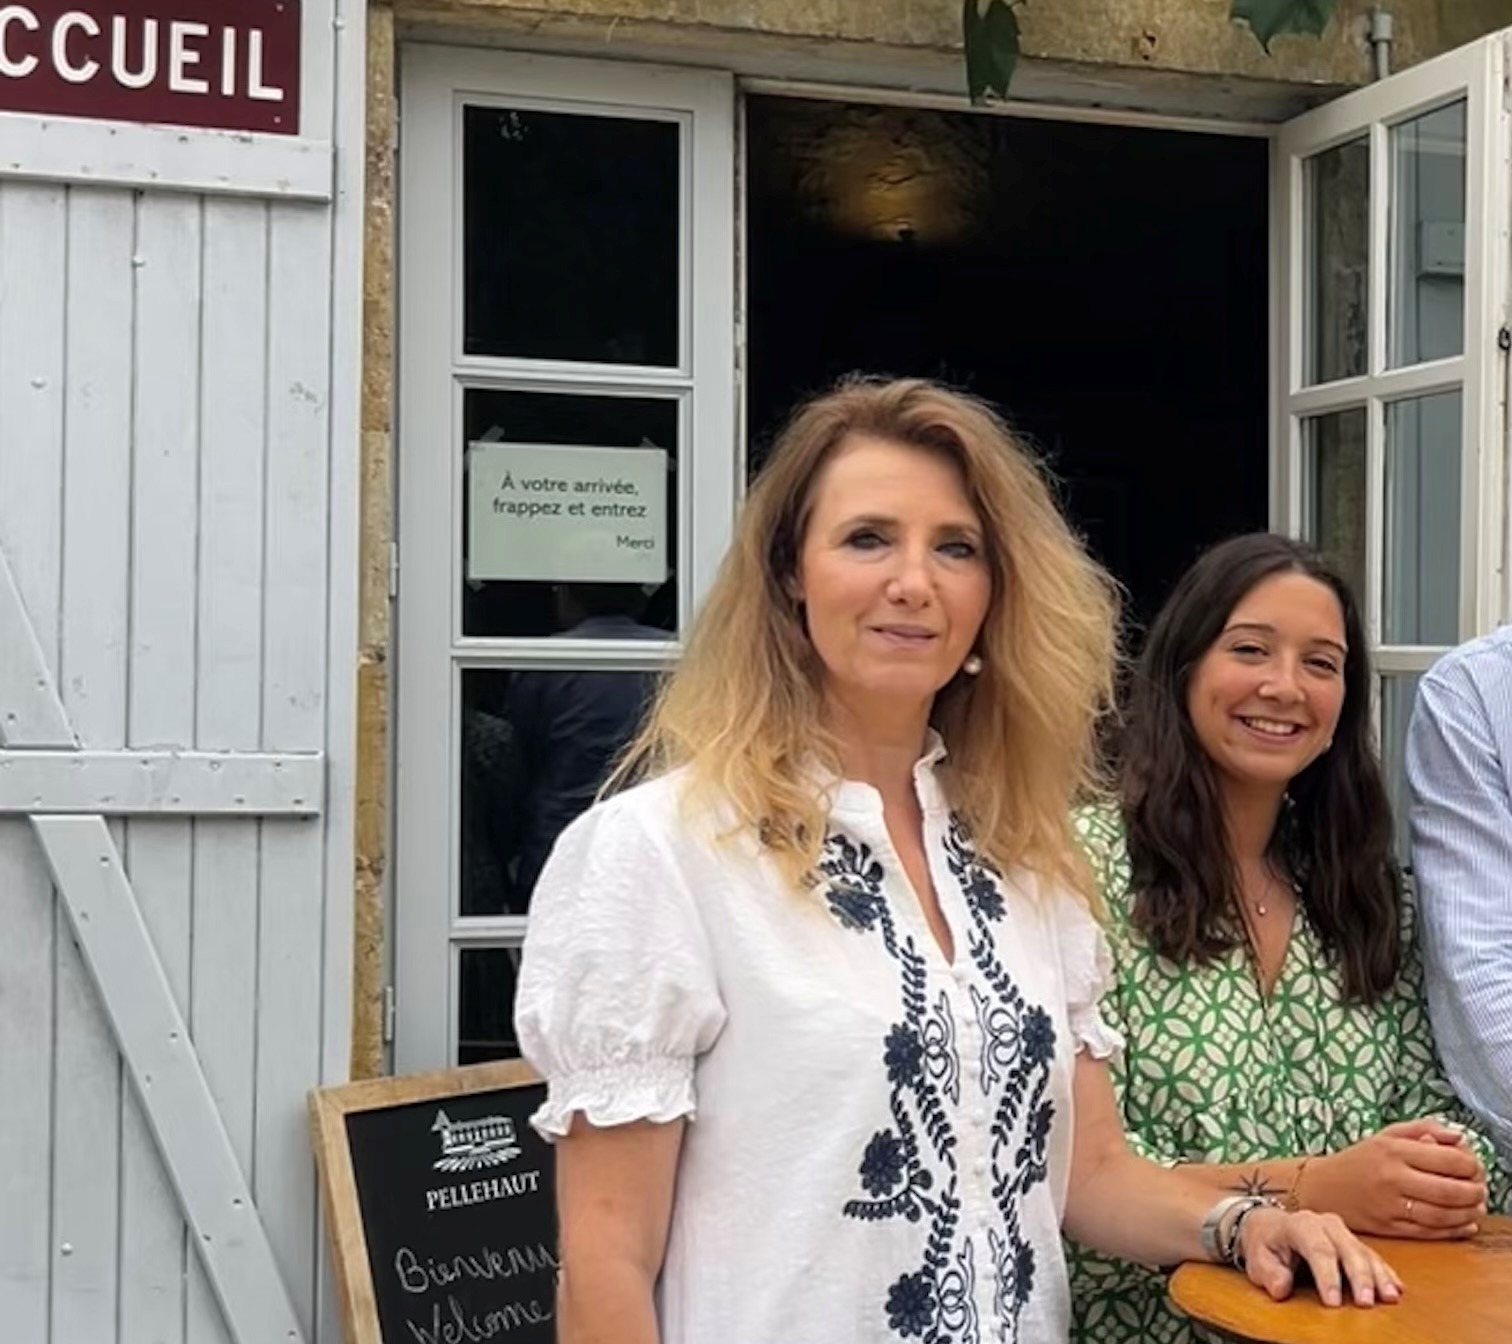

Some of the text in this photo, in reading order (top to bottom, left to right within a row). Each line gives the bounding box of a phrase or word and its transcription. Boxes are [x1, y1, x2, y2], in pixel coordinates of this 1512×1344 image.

[501, 471, 639, 496] À votre arrivée,
[493, 497, 647, 518] frappez et entrez
[616, 534, 655, 549] Merci
[426, 1170, 540, 1211] PELLEHAUT
